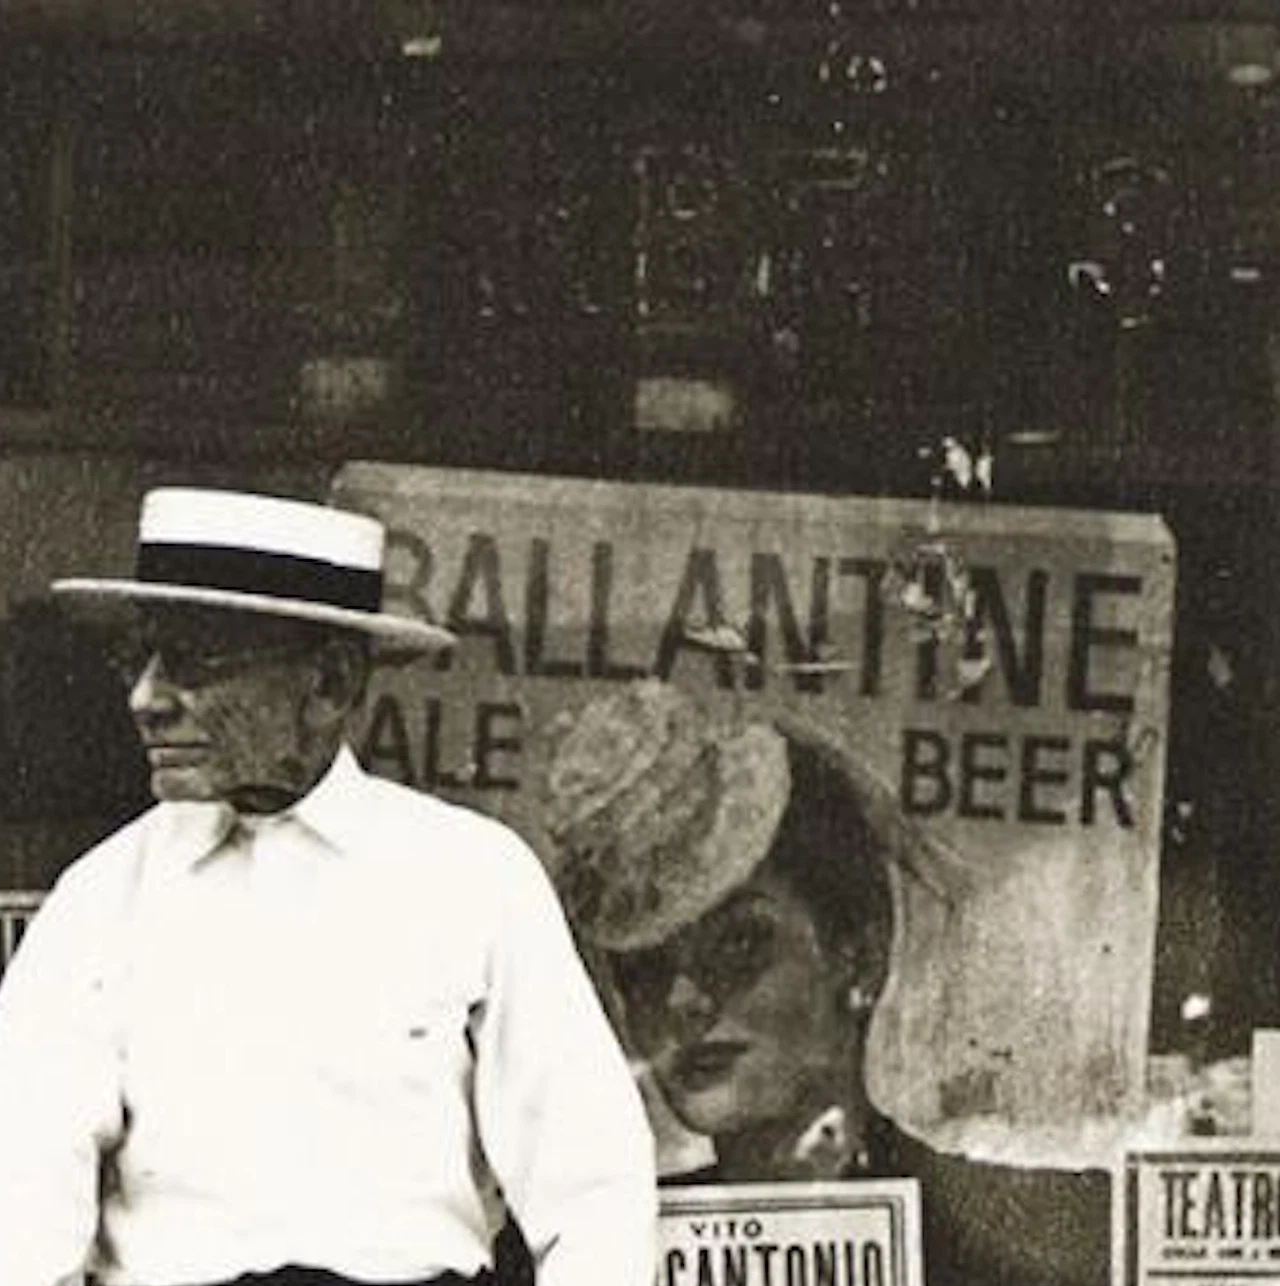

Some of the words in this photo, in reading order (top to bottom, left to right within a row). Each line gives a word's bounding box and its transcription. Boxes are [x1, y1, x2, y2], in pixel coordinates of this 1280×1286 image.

[383, 528, 1142, 714] BALLANTINE
[367, 694, 522, 792] ALE
[900, 729, 1136, 828] BEER
[690, 1218, 763, 1239] VITO
